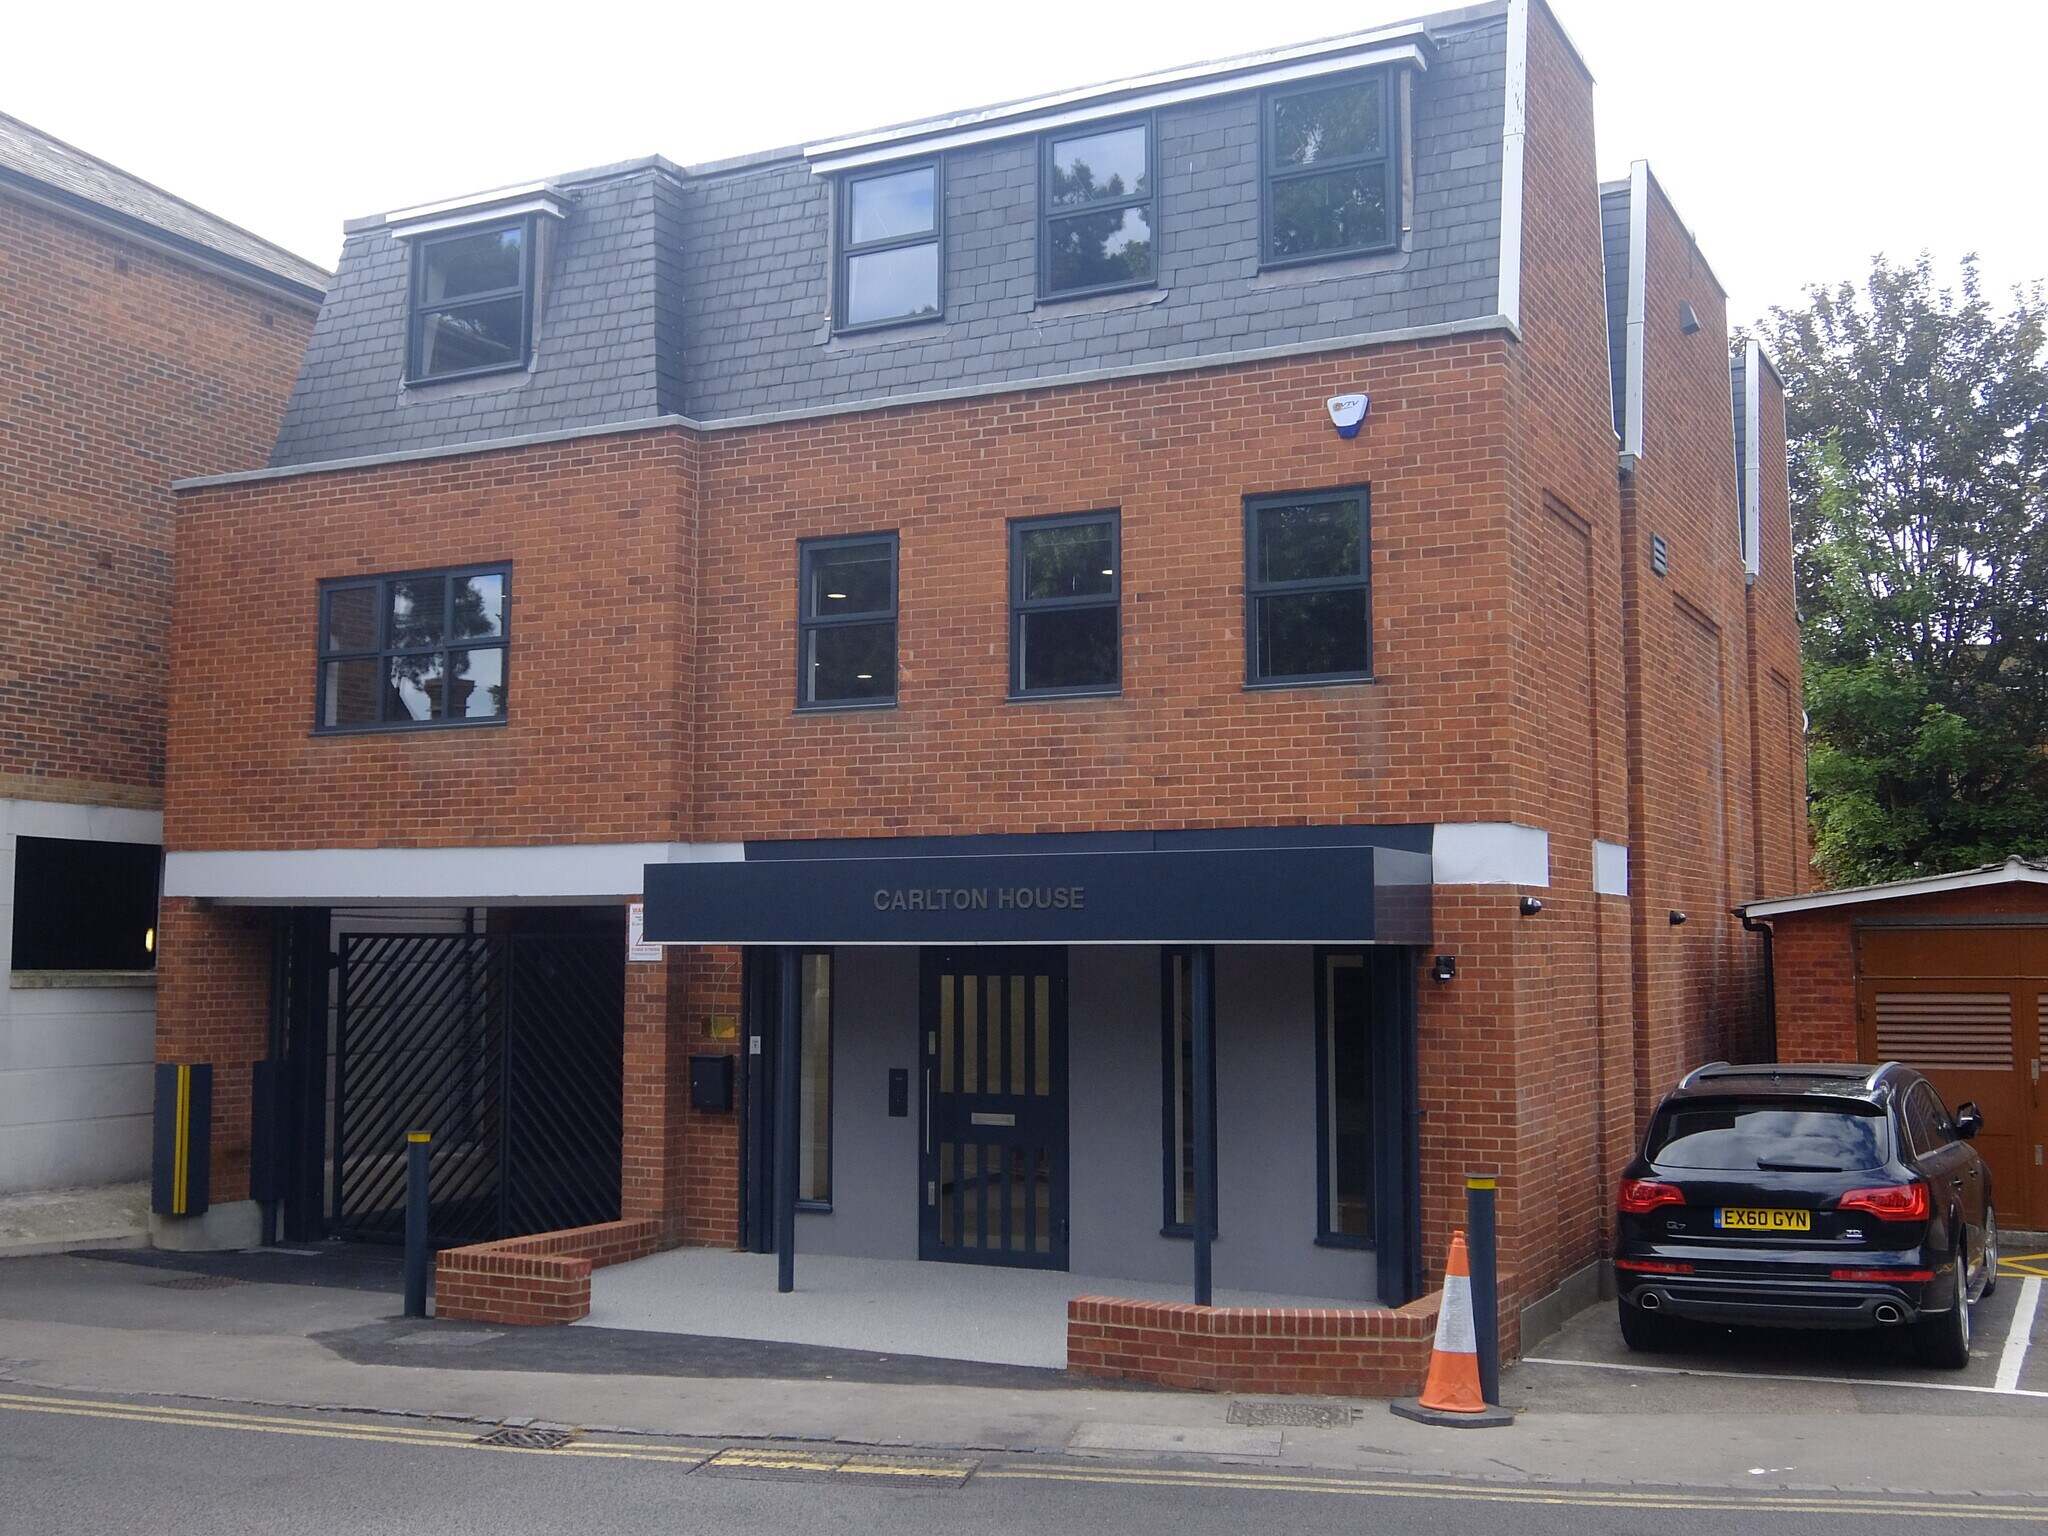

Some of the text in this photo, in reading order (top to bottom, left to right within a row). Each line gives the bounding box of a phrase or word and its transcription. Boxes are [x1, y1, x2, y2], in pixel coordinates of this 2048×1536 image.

[873, 887, 1085, 911] CARLTON HOUSE
[1724, 1210, 1807, 1227] EX60 GYN
